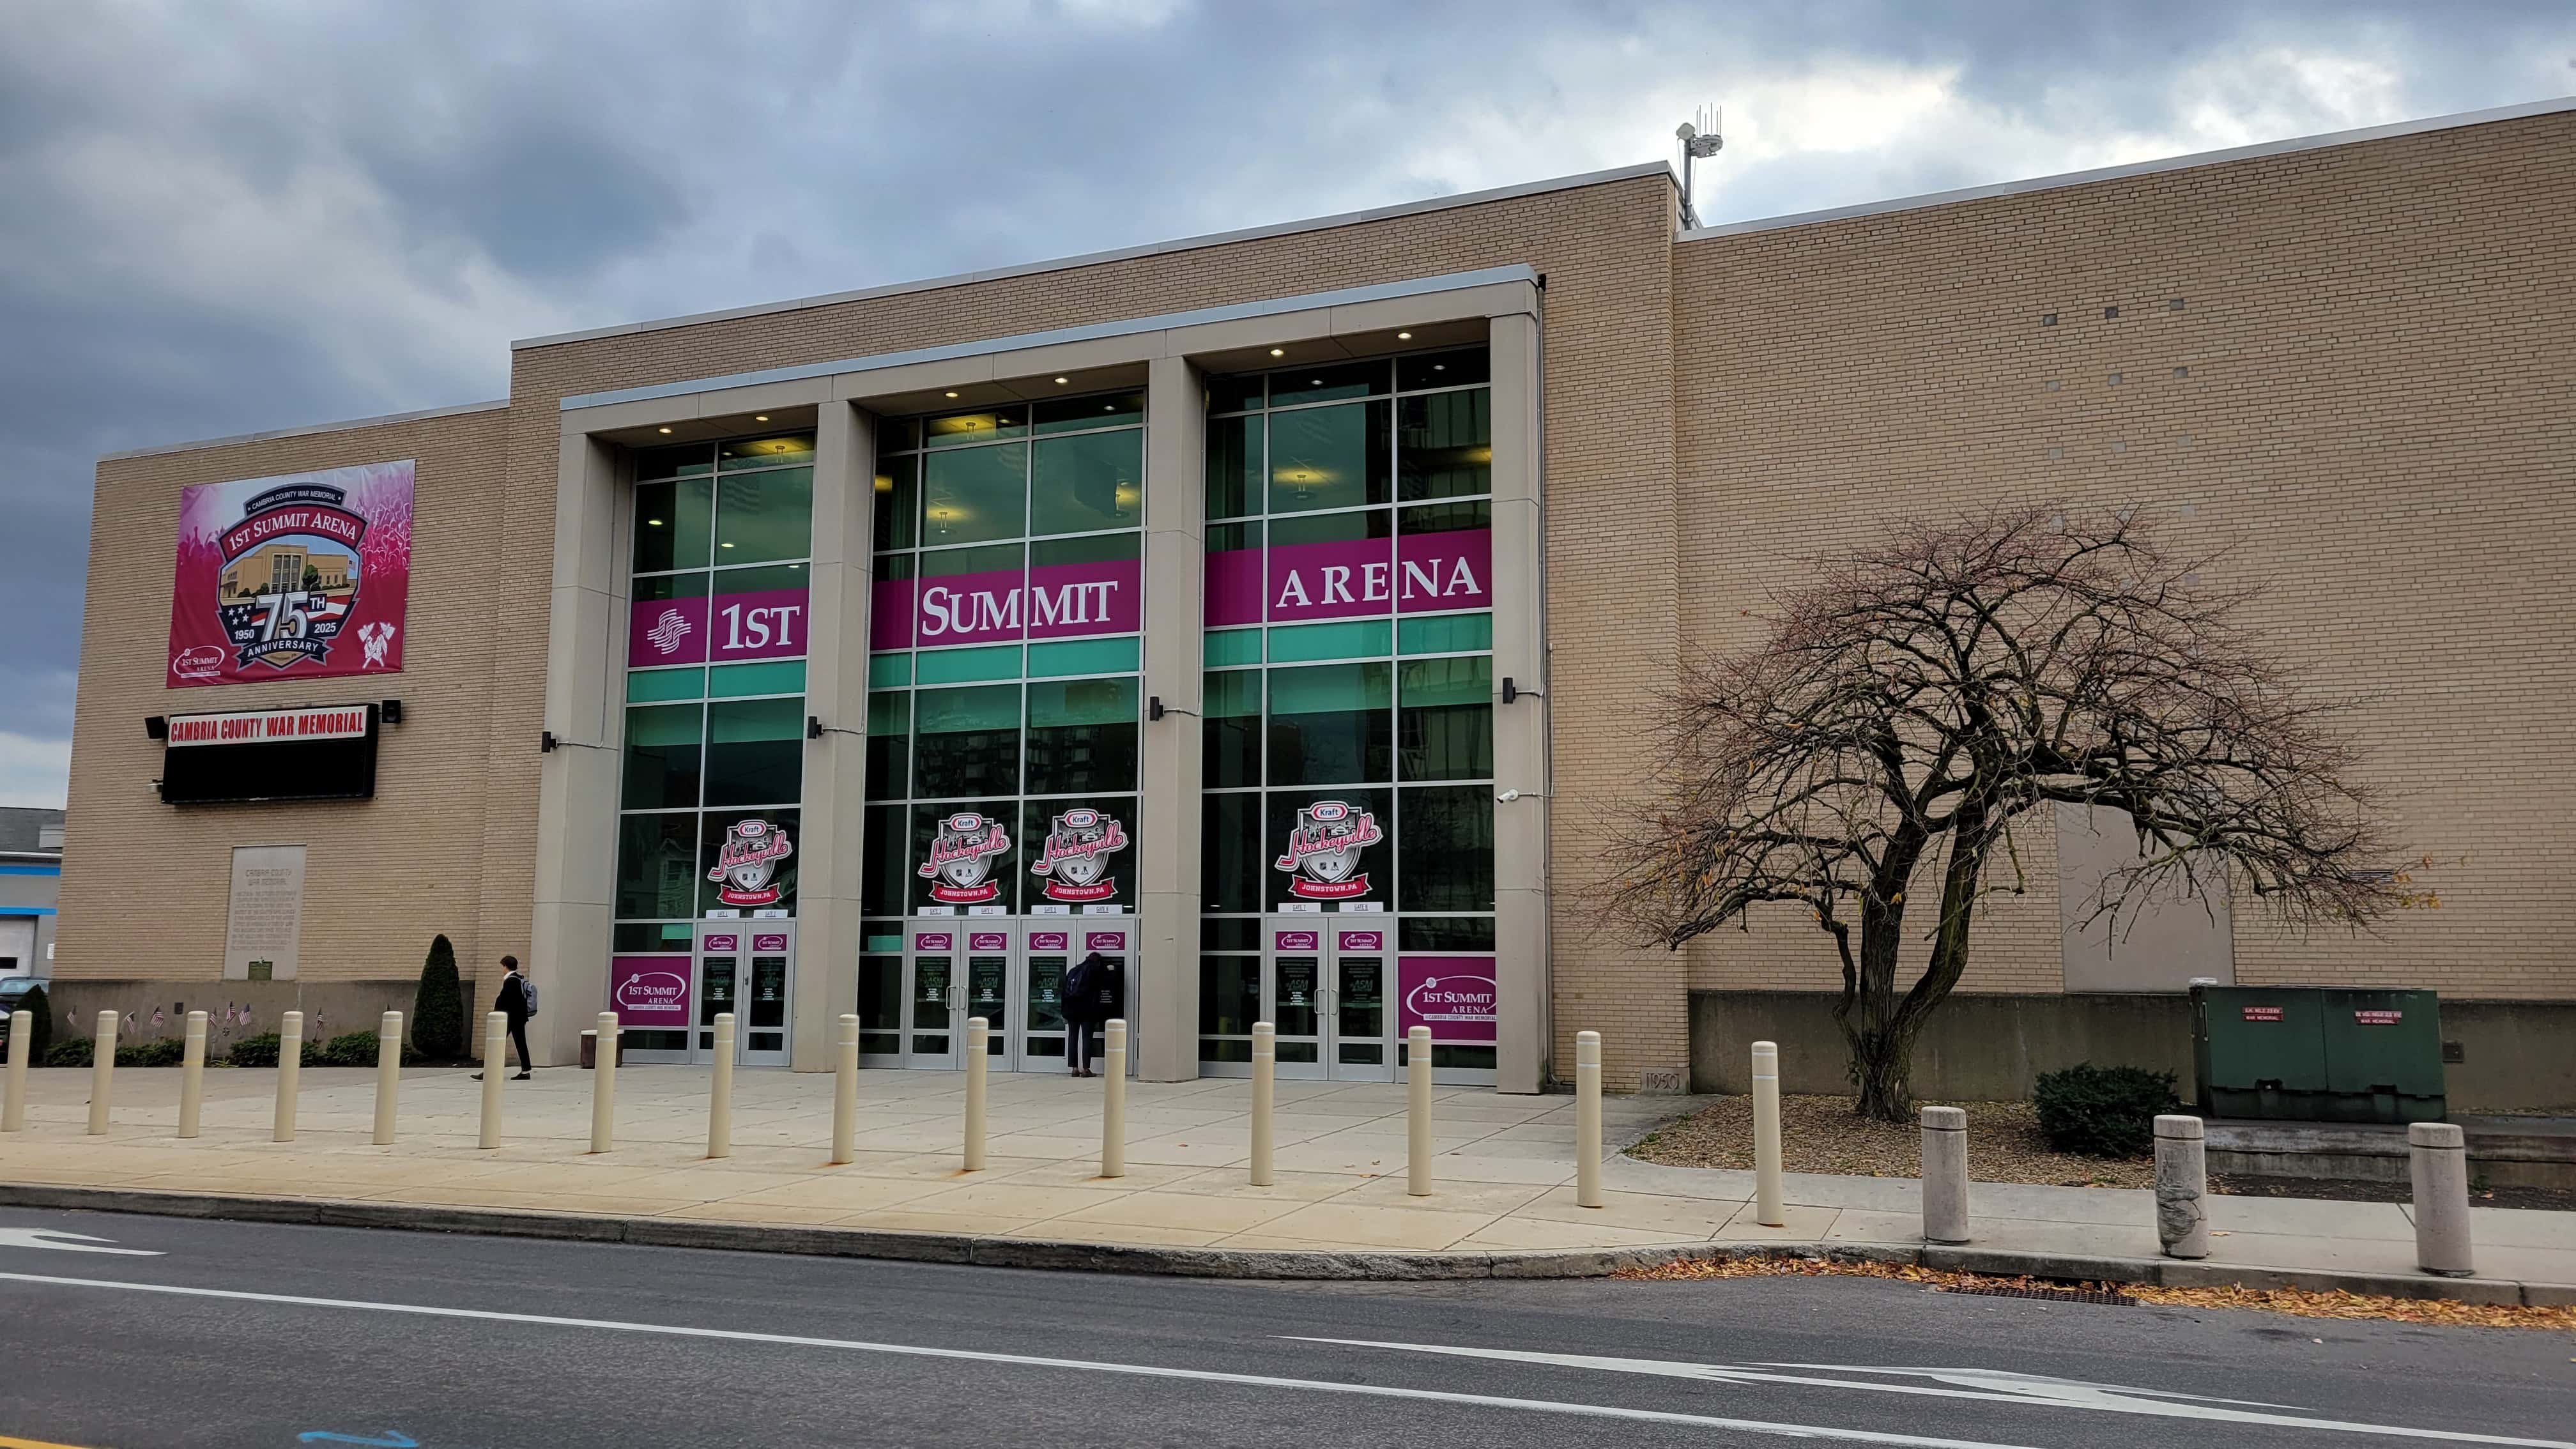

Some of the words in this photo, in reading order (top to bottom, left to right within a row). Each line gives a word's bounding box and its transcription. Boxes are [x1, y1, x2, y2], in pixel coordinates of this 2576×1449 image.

[252, 496, 275, 510] CAMBRIA
[275, 491, 297, 501] COUNTY
[310, 491, 336, 501] MEMORIAL
[229, 528, 250, 551] 1ST
[253, 513, 309, 537] SUMMIT
[310, 512, 356, 540] ARENA
[256, 591, 309, 642] 75
[721, 603, 800, 650] 1ST
[922, 580, 1118, 636] SUMMIT
[1275, 556, 1482, 608] ARENA
[234, 629, 254, 640] 1950
[314, 622, 337, 634] 2025
[193, 657, 218, 665] SUMMIT
[247, 640, 319, 657] ANNIVERSARY
[171, 720, 217, 742] CAMBRIA
[221, 717, 262, 740] COUNTY
[266, 716, 295, 737] WAR
[298, 712, 363, 735] MEMORIAL
[711, 832, 787, 875] Hockeyville
[923, 827, 1005, 871] Hockeyville
[1035, 823, 1124, 870] Hockeyville
[1279, 816, 1376, 865] Hockeyville
[629, 986, 643, 995] 1ST
[643, 986, 677, 995] SUMMIT
[1423, 992, 1443, 1002] 1ST
[1444, 992, 1492, 1003] SUMMIT
[1646, 1073, 1680, 1089] 1950
